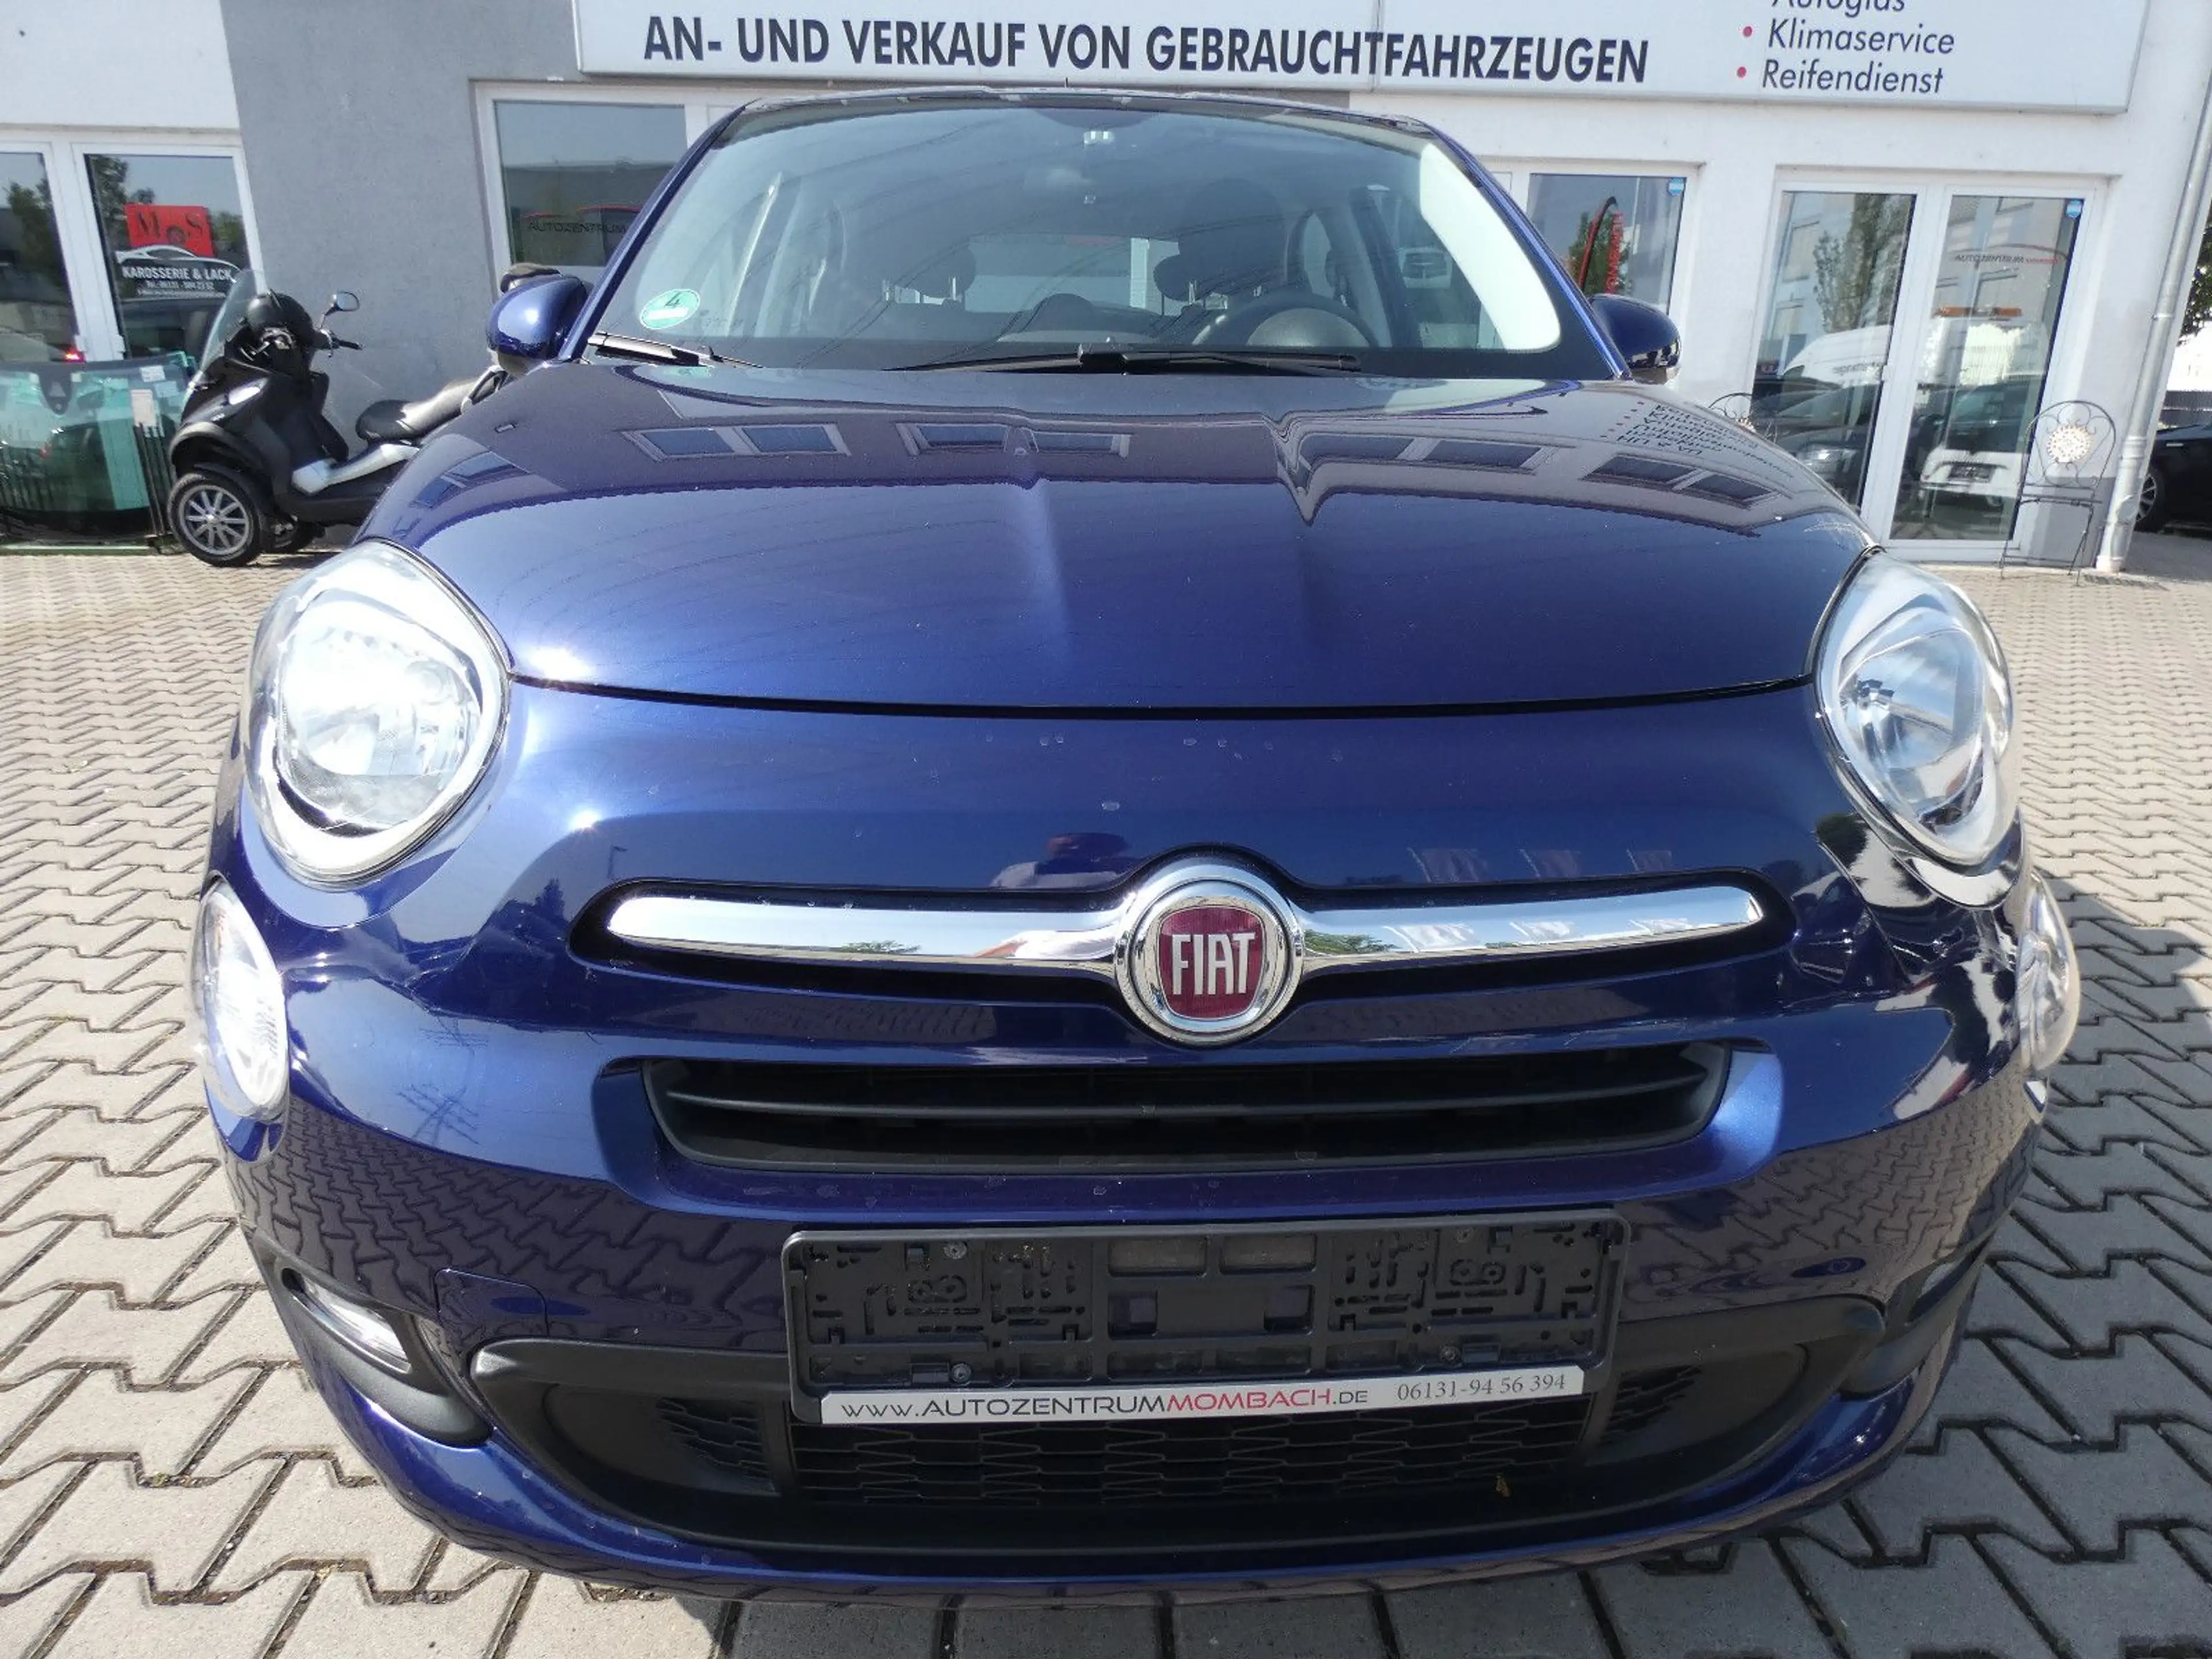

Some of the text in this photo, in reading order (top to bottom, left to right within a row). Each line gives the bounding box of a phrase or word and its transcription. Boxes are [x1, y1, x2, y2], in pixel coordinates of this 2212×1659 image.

[644, 16, 1649, 83] AN- UND VERKAUF VON GEBRAUCHTFAHRZEUGEN
[1768, 18, 1955, 54] Klimaservice
[1762, 59, 1944, 93] Reifendienst
[122, 266, 191, 280] KAROSSERIE
[1172, 933, 1256, 995] FIAT
[1397, 1377, 1493, 1400] 06131-94
[1501, 1376, 1523, 1393] 56
[1529, 1373, 1566, 1391] 394
